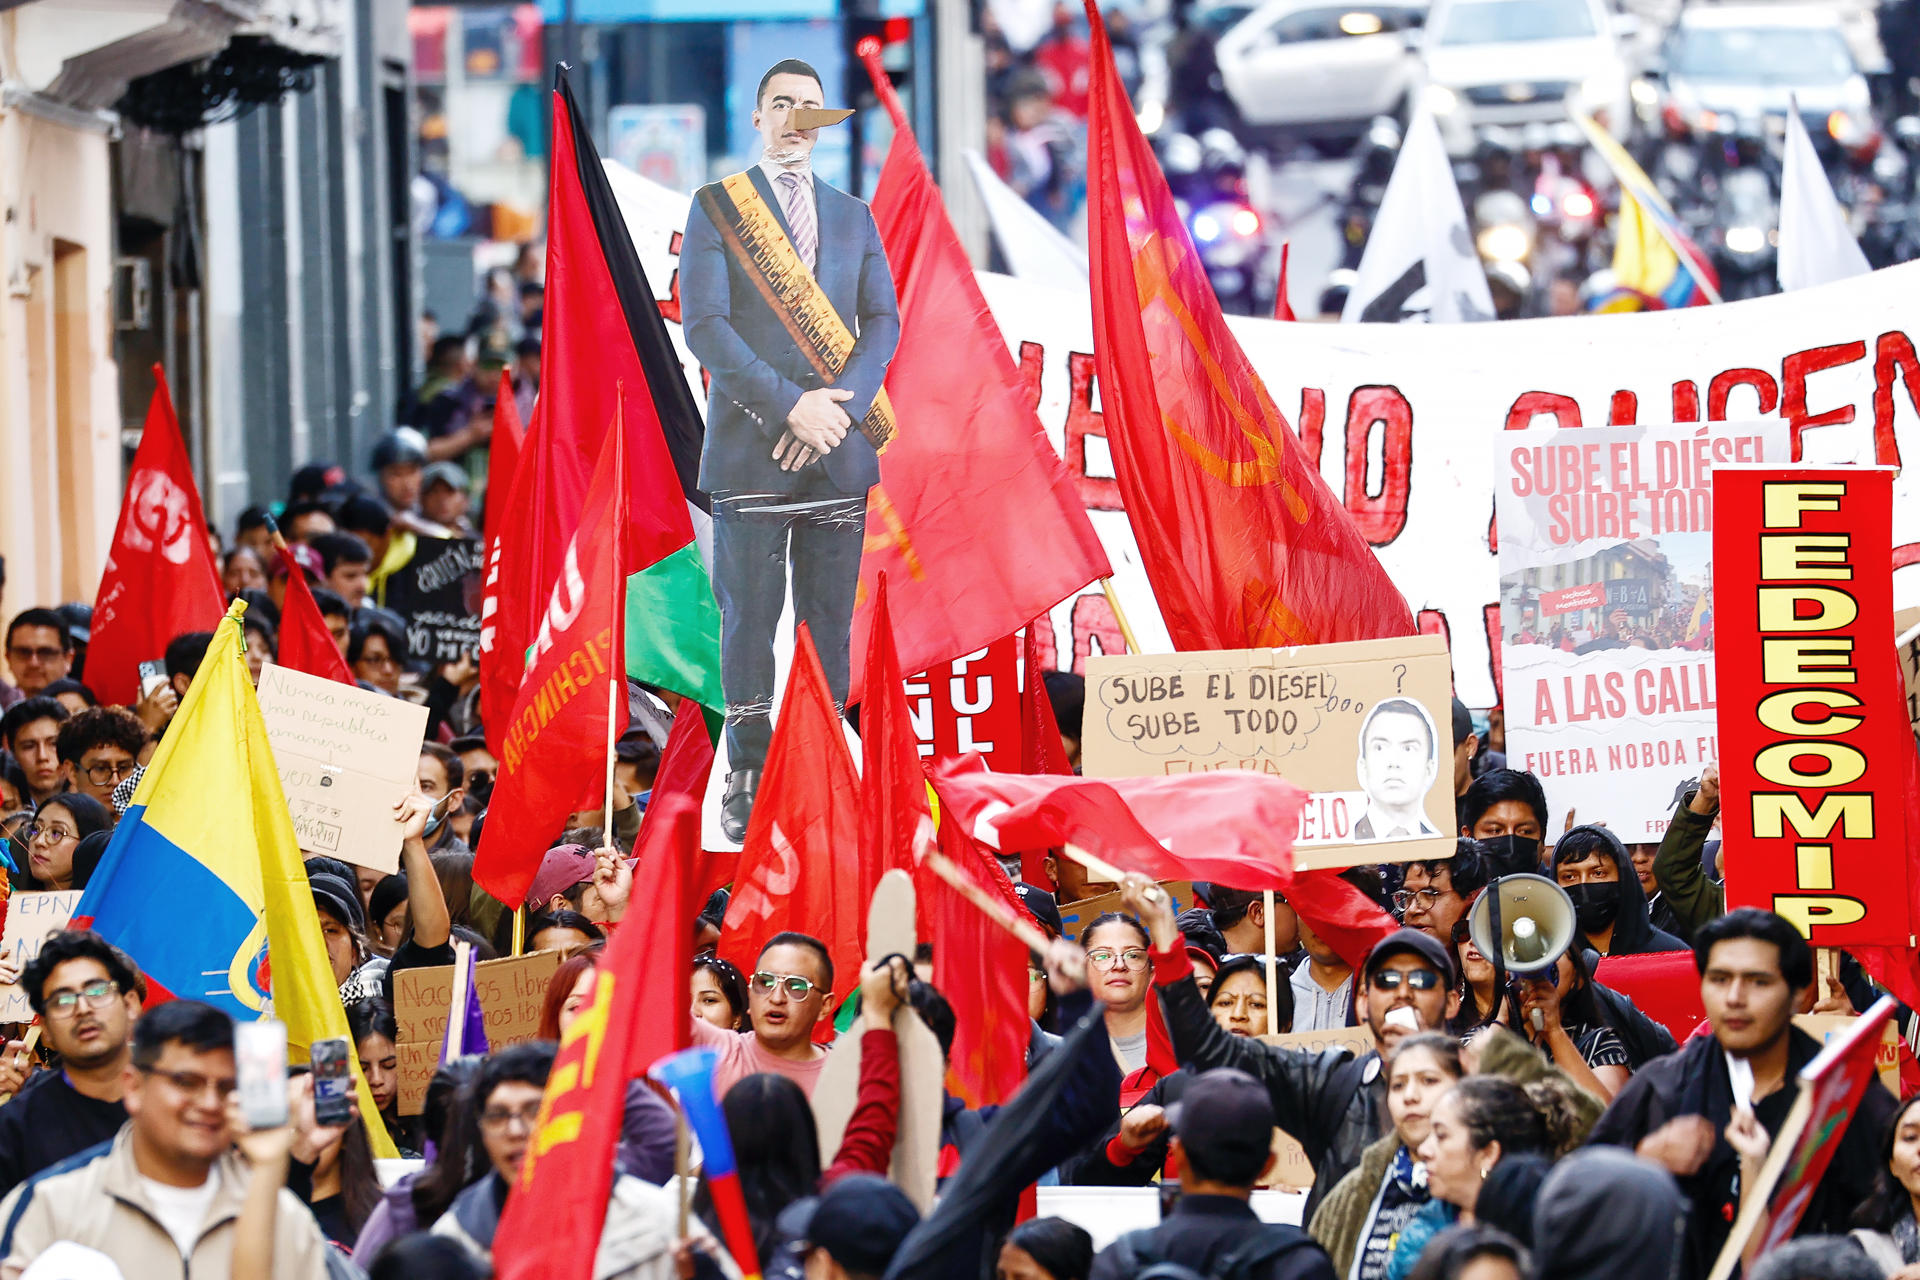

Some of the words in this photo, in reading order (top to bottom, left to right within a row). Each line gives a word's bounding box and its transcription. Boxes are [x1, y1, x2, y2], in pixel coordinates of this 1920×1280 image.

[1511, 444, 1602, 497] SUBE
[1610, 442, 1650, 492] EL
[1548, 492, 1640, 545] SUBE
[1645, 489, 1712, 535] TOD
[267, 671, 335, 704] Nunca
[1112, 675, 1184, 704] SUBE
[1207, 675, 1235, 700] EL
[1250, 672, 1328, 702] DIESEL
[1535, 679, 1557, 725] A
[1564, 671, 1627, 722] LAS
[1634, 664, 1717, 716] CALL
[1127, 712, 1200, 740] SUBE
[1224, 709, 1298, 735] TODO
[1750, 481, 1875, 942] FEDECOMIP
[269, 728, 352, 753] ananera
[1526, 747, 1598, 777] FUERA
[1608, 739, 1687, 771] NOBOA
[20, 894, 73, 915] EPN
